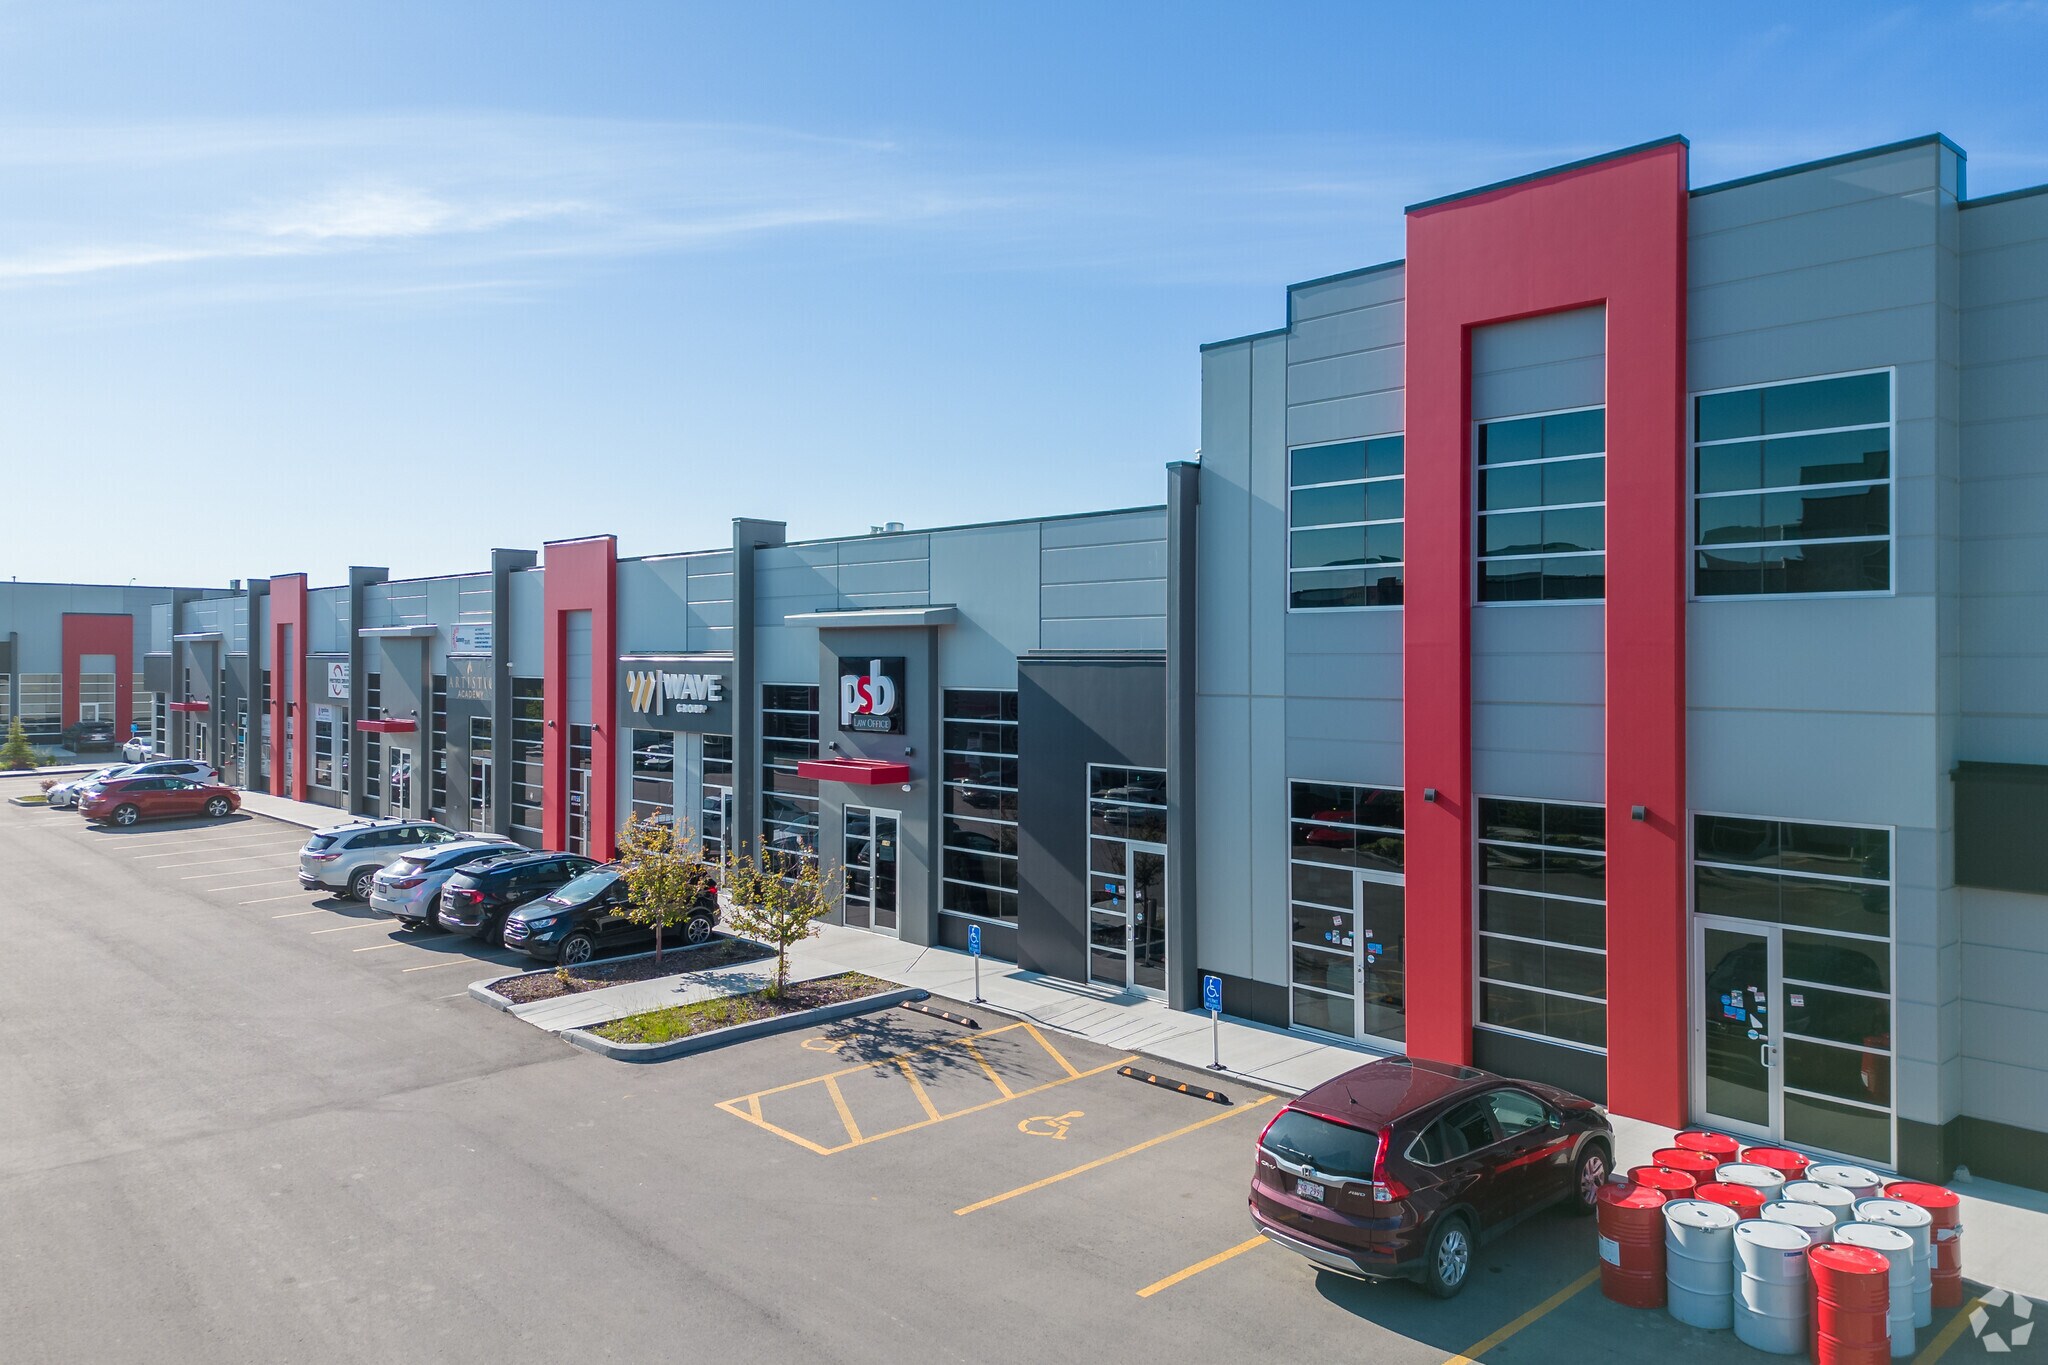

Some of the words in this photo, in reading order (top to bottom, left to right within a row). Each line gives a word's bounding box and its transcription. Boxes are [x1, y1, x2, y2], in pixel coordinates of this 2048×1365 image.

[663, 673, 723, 701] WAVE
[841, 659, 895, 725] psb
[458, 689, 484, 699] ACADEMY
[675, 703, 708, 714] GROUP
[867, 718, 889, 729] OFFICE
